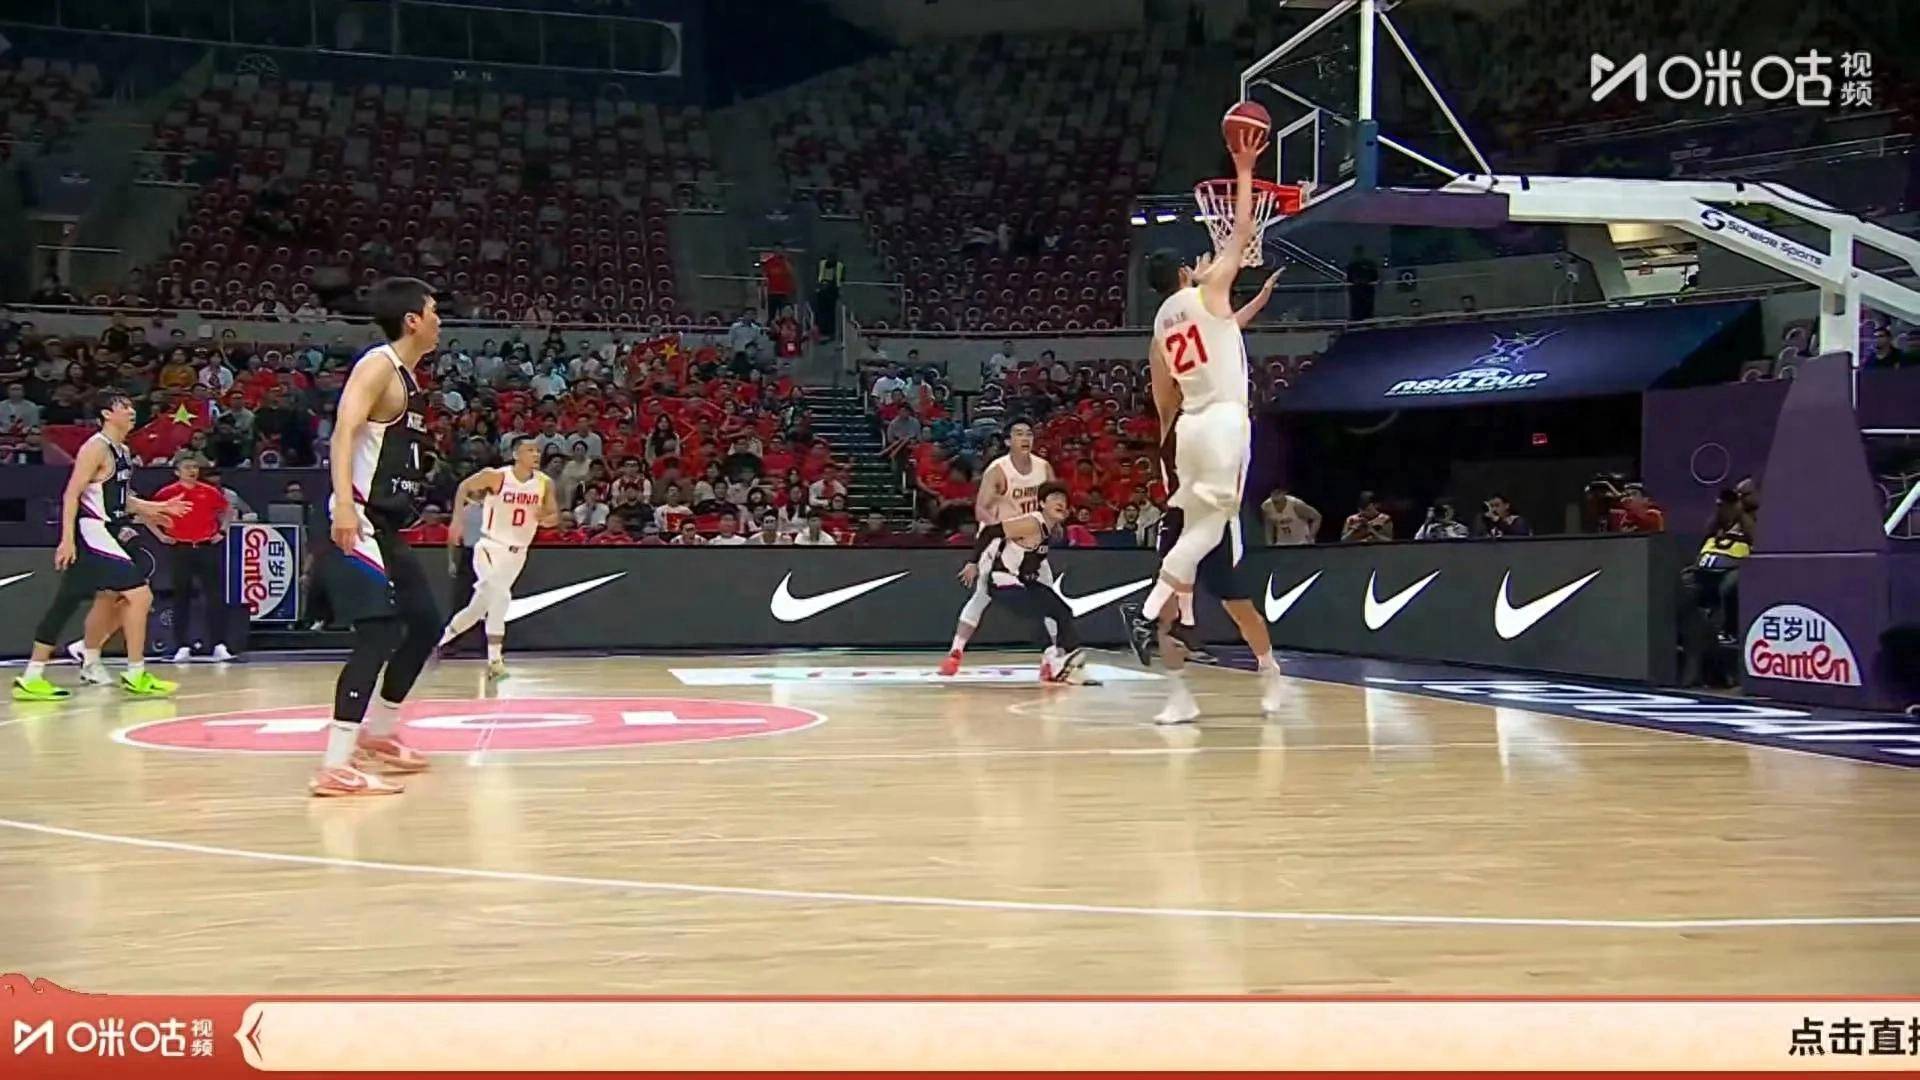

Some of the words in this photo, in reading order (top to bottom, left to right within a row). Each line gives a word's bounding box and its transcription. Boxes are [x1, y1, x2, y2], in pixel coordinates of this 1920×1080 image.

[1780, 242, 1822, 265] Sports
[1166, 324, 1208, 373] 21
[1389, 377, 1473, 392] ASIA
[1475, 372, 1548, 388] CUP
[503, 491, 539, 505] CHINA
[512, 508, 525, 527] 0
[268, 541, 285, 597] 百岁山
[1762, 616, 1826, 642] 百岁山
